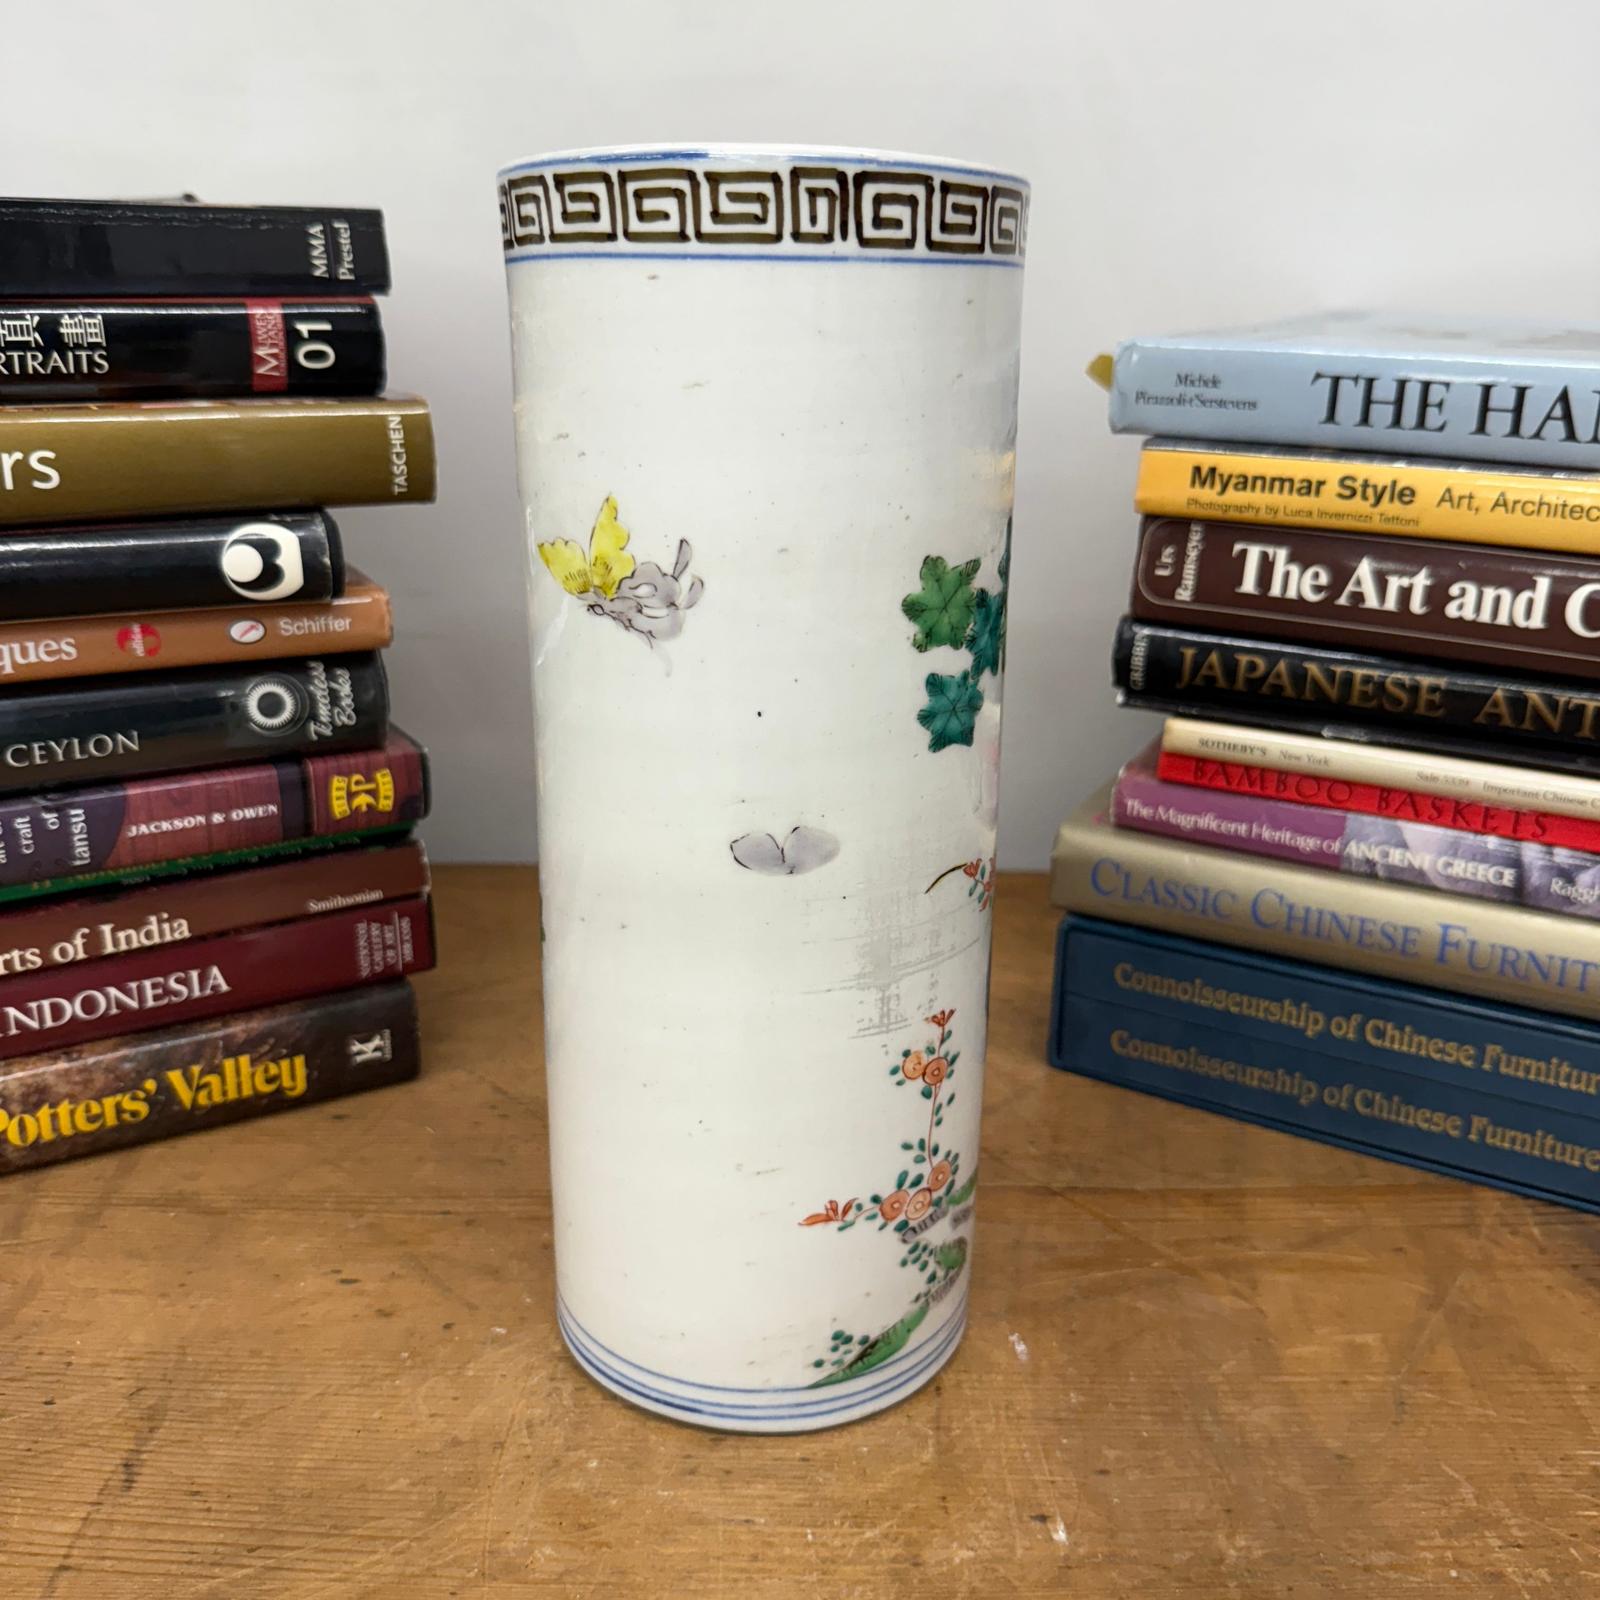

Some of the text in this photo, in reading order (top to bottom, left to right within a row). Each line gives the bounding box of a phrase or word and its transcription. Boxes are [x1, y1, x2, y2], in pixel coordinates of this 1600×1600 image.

[309, 222, 331, 279] MMA
[334, 219, 355, 280] Prestel
[294, 320, 336, 370] 01
[1311, 371, 1451, 434] THE
[1, 449, 61, 490] rs
[389, 416, 408, 495] TASCHEN
[1186, 498, 1260, 519] Photography
[1264, 503, 1280, 518] by
[1282, 505, 1313, 519] Luca
[1316, 507, 1374, 524] Invernizzi
[1190, 465, 1600, 523] Myanmar Style Art, Architec
[1154, 544, 1177, 576] Urs
[1232, 541, 1328, 604] The
[1335, 556, 1432, 615] Art
[1444, 577, 1553, 629] and
[280, 616, 352, 637] Schiffer
[1176, 646, 1600, 739] JAPANESE ANT
[6, 729, 141, 768] CEYLON
[1199, 737, 1267, 756] SOTHEBY'S
[1279, 750, 1301, 763] New
[1306, 754, 1330, 767] York
[1483, 782, 1540, 800] Important
[1542, 790, 1588, 806] Chinese
[41, 812, 60, 830] of
[126, 804, 278, 839] JACKSON & OWEN
[1193, 760, 1548, 839] BAMBOO BASKETS
[14, 816, 35, 854] craft
[70, 808, 91, 866] tansu
[1124, 798, 1518, 888] The Magnificent Heritage of ANCIENT GREECE
[309, 889, 384, 912] Smithsonian
[1090, 857, 1600, 993] CLASSIC CHINESE FURNIT
[53, 929, 89, 961] of
[101, 912, 192, 954] India
[0, 965, 232, 1037] NDONESIA
[1113, 962, 1325, 1039] Connoisseurship
[1330, 1012, 1360, 1041] of
[1364, 1017, 1475, 1067] Chinese
[165, 1054, 308, 1111] Valley
[1110, 1029, 1600, 1172] Connoisseurship of Chinese Furniture
